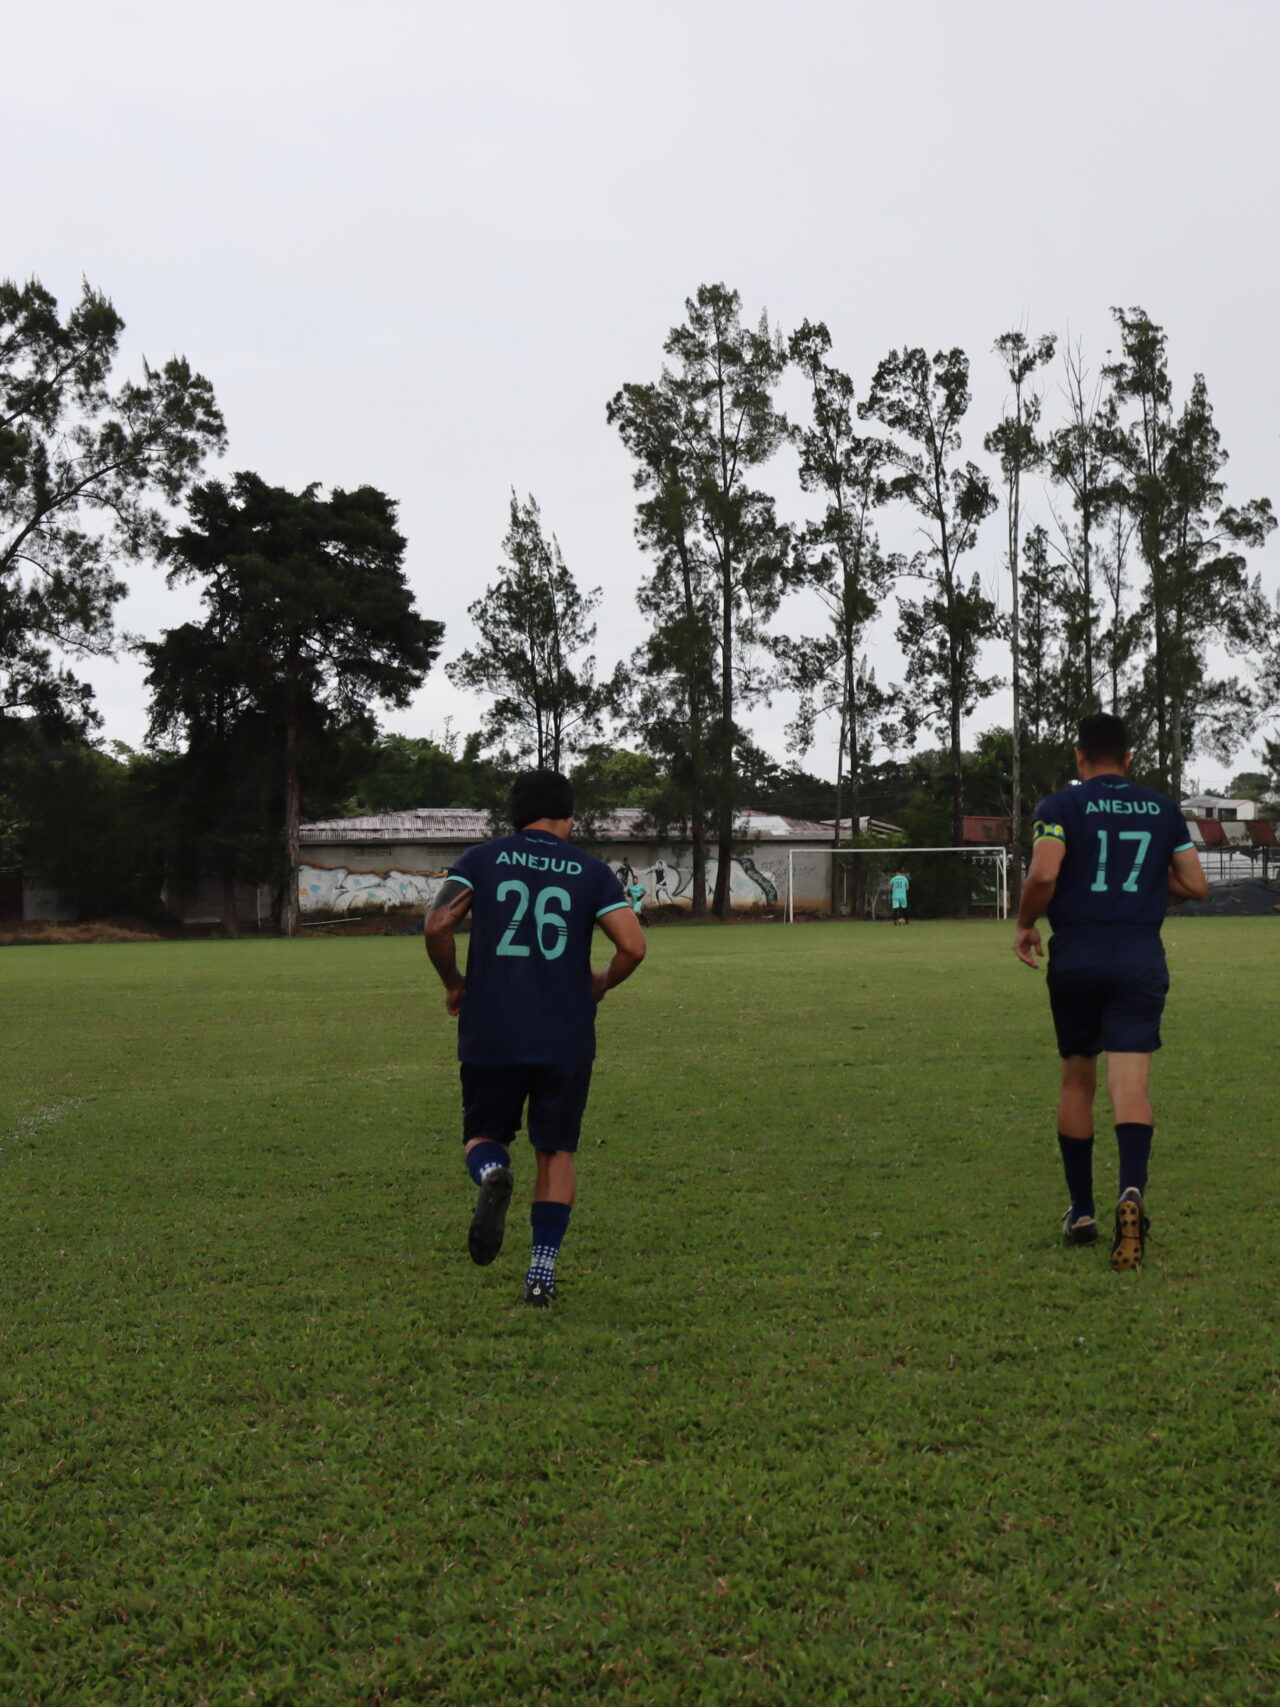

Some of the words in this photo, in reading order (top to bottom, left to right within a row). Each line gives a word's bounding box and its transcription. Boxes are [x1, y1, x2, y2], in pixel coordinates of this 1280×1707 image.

[1085, 799, 1161, 815] ANEJUD
[495, 851, 583, 875] ANEJUD
[1090, 830, 1153, 892] 17
[496, 879, 572, 961] 26
